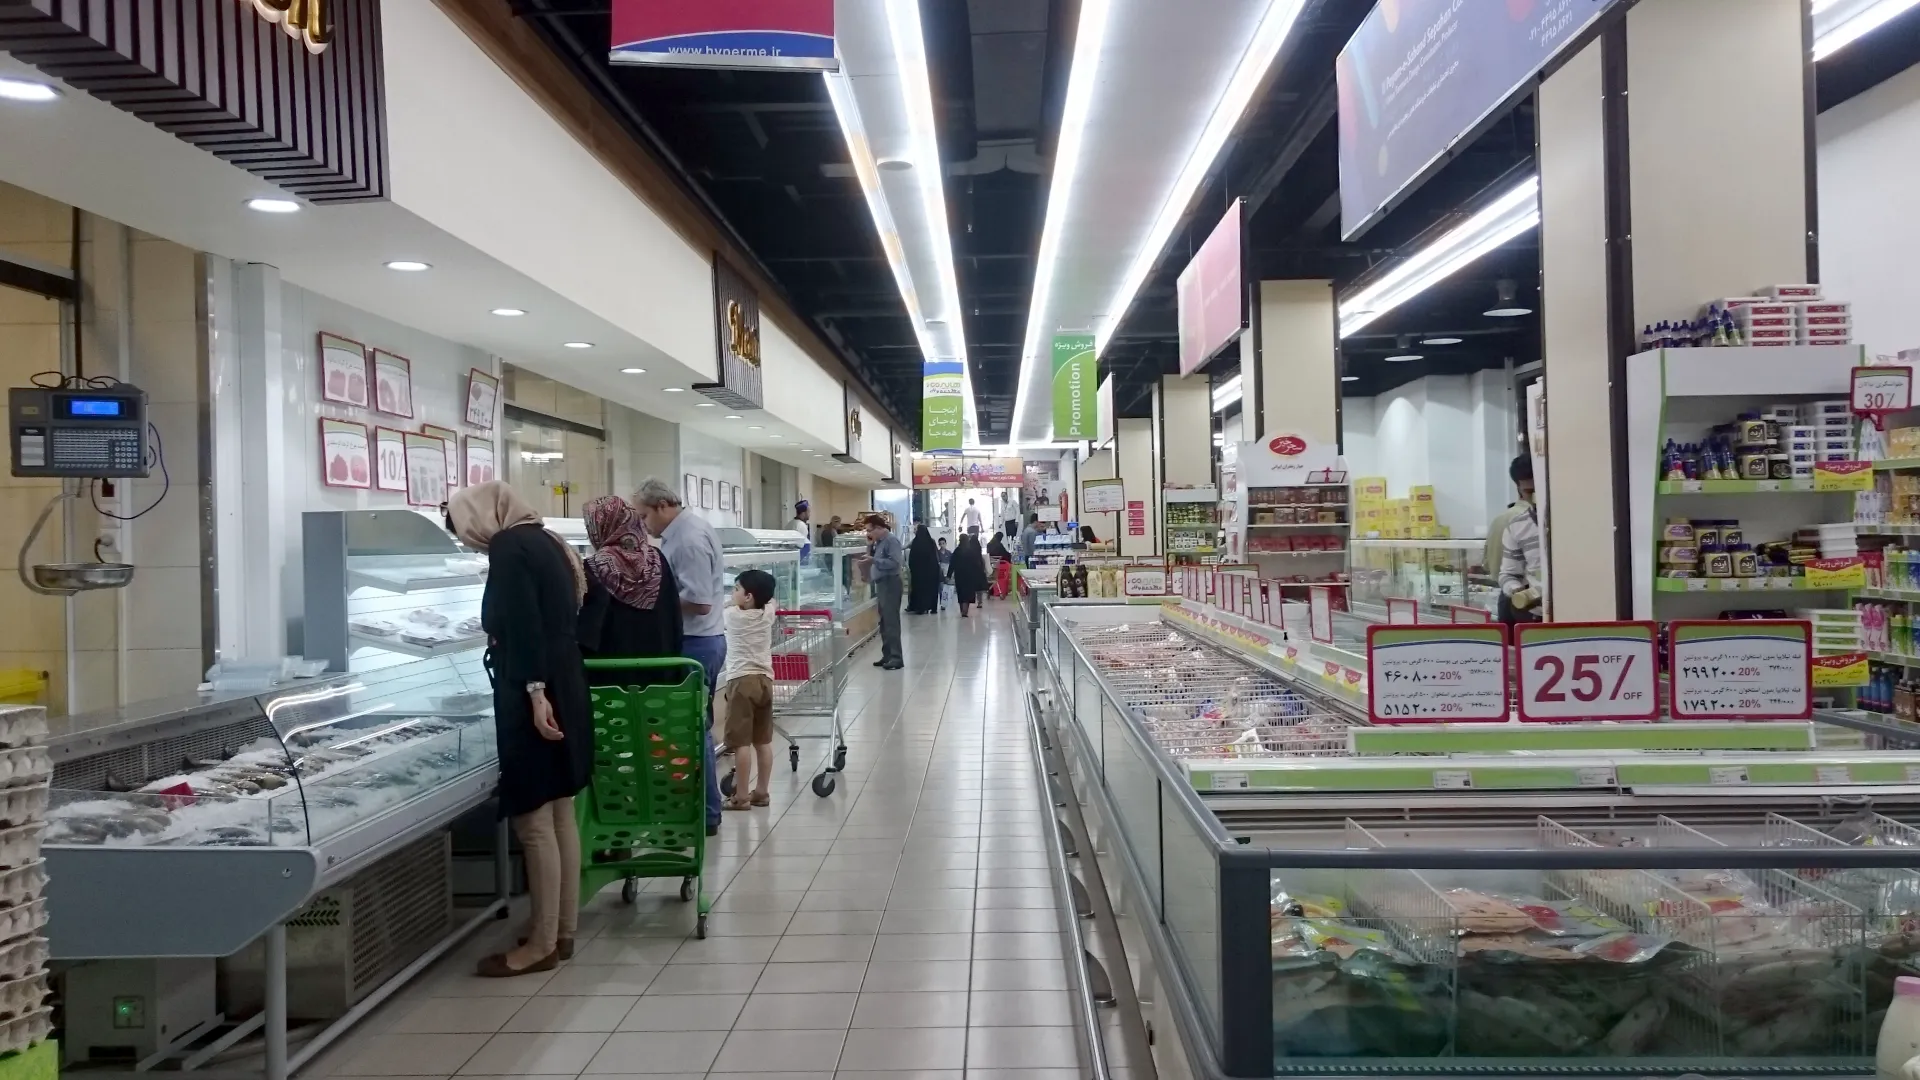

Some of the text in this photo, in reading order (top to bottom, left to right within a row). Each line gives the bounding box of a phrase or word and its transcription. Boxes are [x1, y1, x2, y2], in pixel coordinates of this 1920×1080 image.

[1068, 362, 1081, 435] Promotion
[928, 406, 958, 416] اینجا
[928, 416, 948, 426] جای
[928, 428, 940, 438] جا
[1602, 655, 1622, 664] OFF
[1440, 671, 1462, 680] 20%
[1738, 667, 1760, 676] 20%
[1623, 692, 1642, 700] OFF
[1440, 703, 1463, 712] 20%
[1738, 700, 1762, 708] 20%
